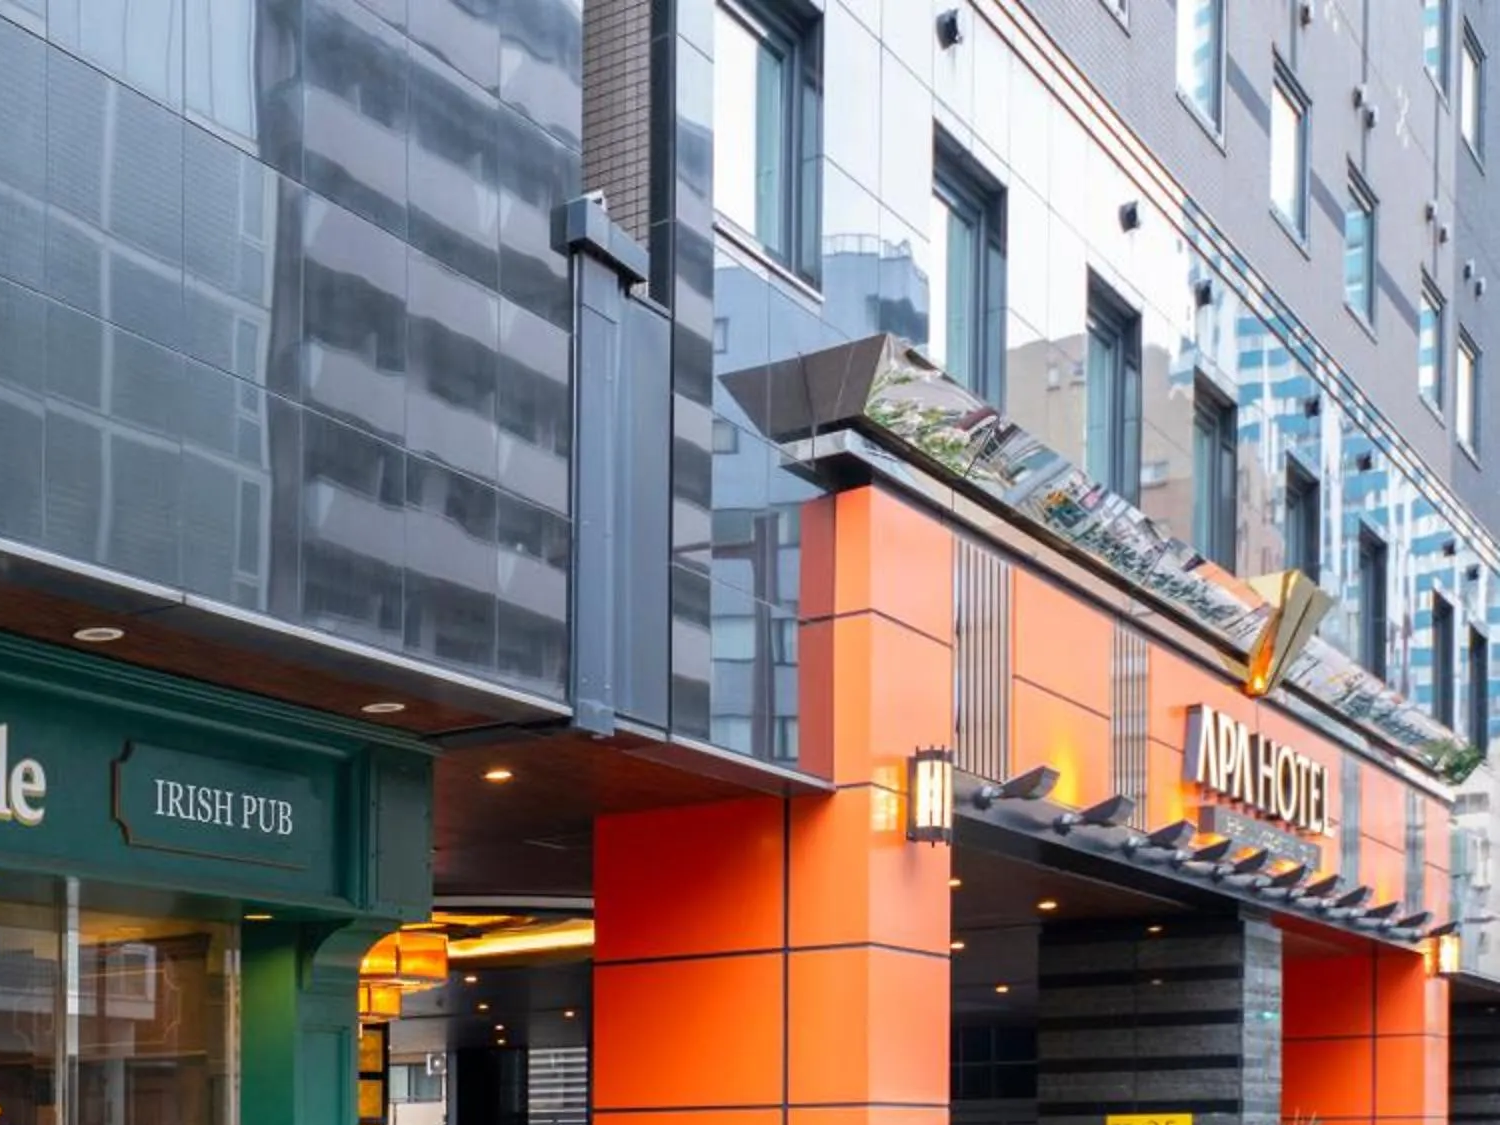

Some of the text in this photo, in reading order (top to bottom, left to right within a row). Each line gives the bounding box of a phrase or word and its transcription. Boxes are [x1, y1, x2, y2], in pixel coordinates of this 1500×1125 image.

[154, 778, 294, 837] IRISH PUB
[1197, 703, 1335, 838] APA HOTEL
